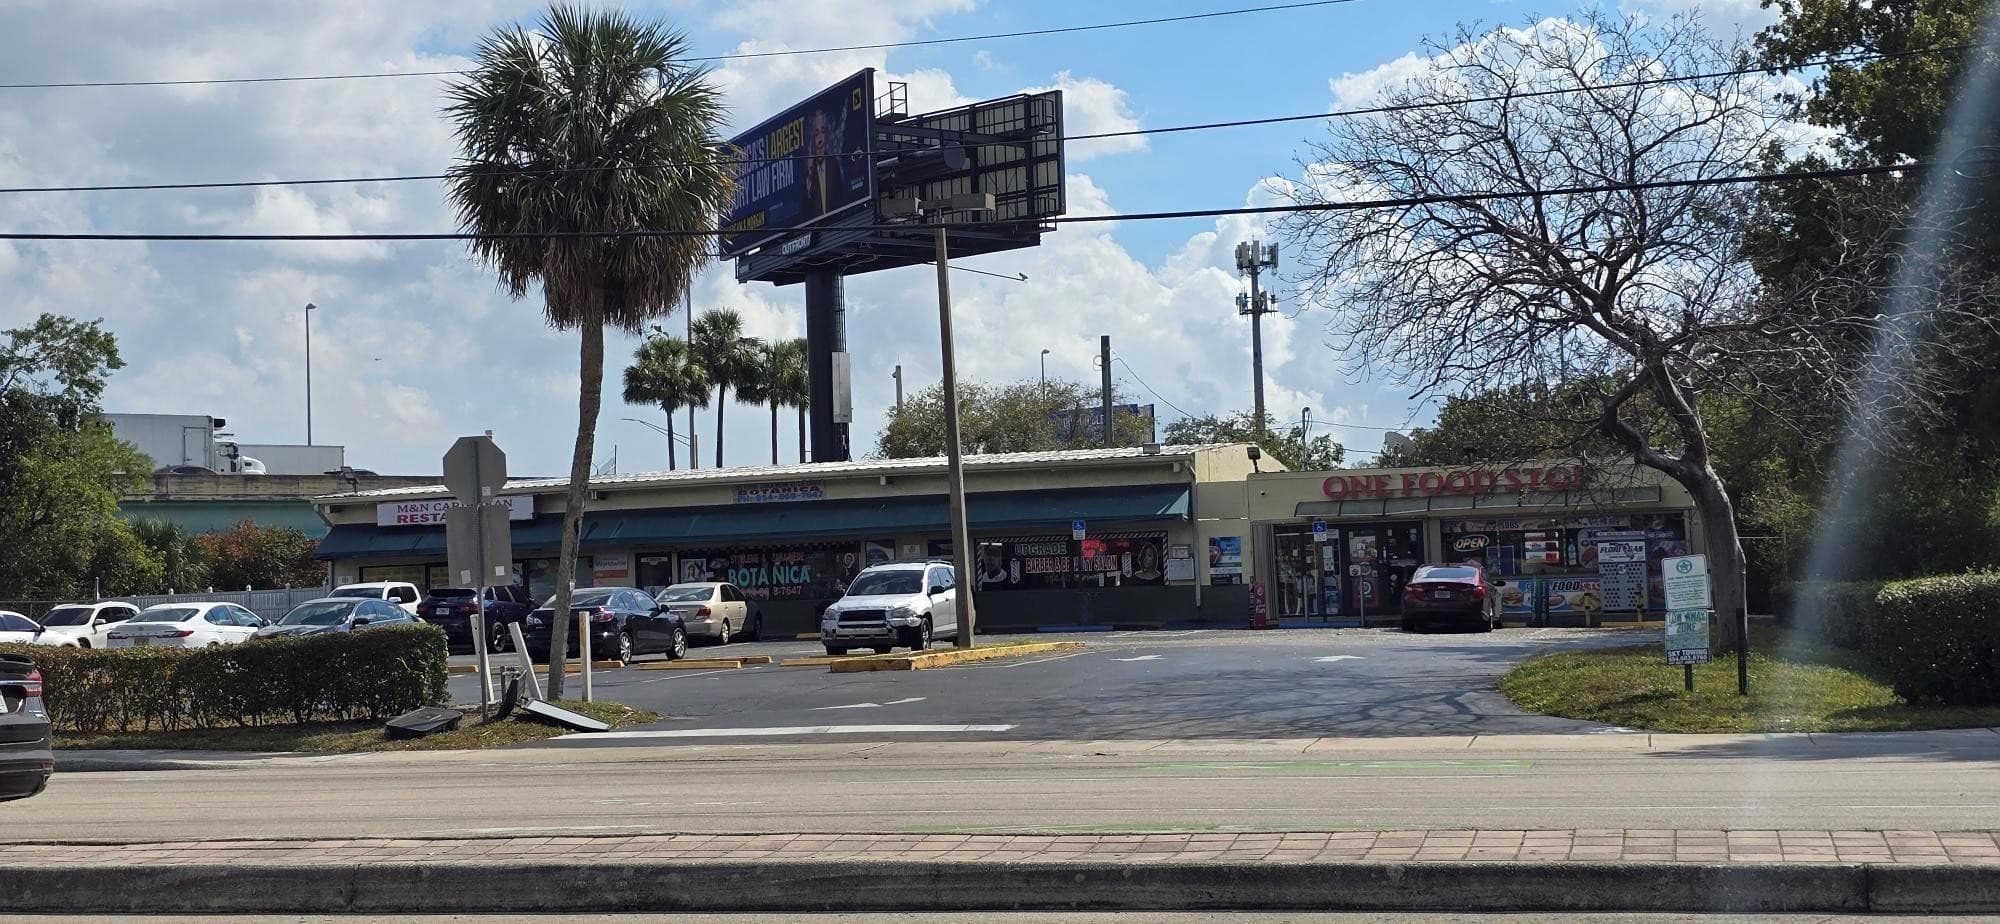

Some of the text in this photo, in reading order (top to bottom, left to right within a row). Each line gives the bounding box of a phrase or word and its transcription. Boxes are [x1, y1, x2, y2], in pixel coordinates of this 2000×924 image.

[766, 116, 805, 163] LARGEST
[752, 166, 771, 202] LAW
[772, 156, 794, 192] FIRM
[1322, 474, 1393, 499] ONE
[1400, 470, 1498, 497] FOOD
[397, 503, 430, 513] M&N
[1014, 542, 1067, 556] UPGRADE
[1455, 536, 1486, 549] OPEN
[1025, 558, 1054, 574] BARBER
[1552, 581, 1581, 591] FOOD
[1676, 622, 1697, 633] ZONE
[1682, 648, 1708, 656] TOWING
